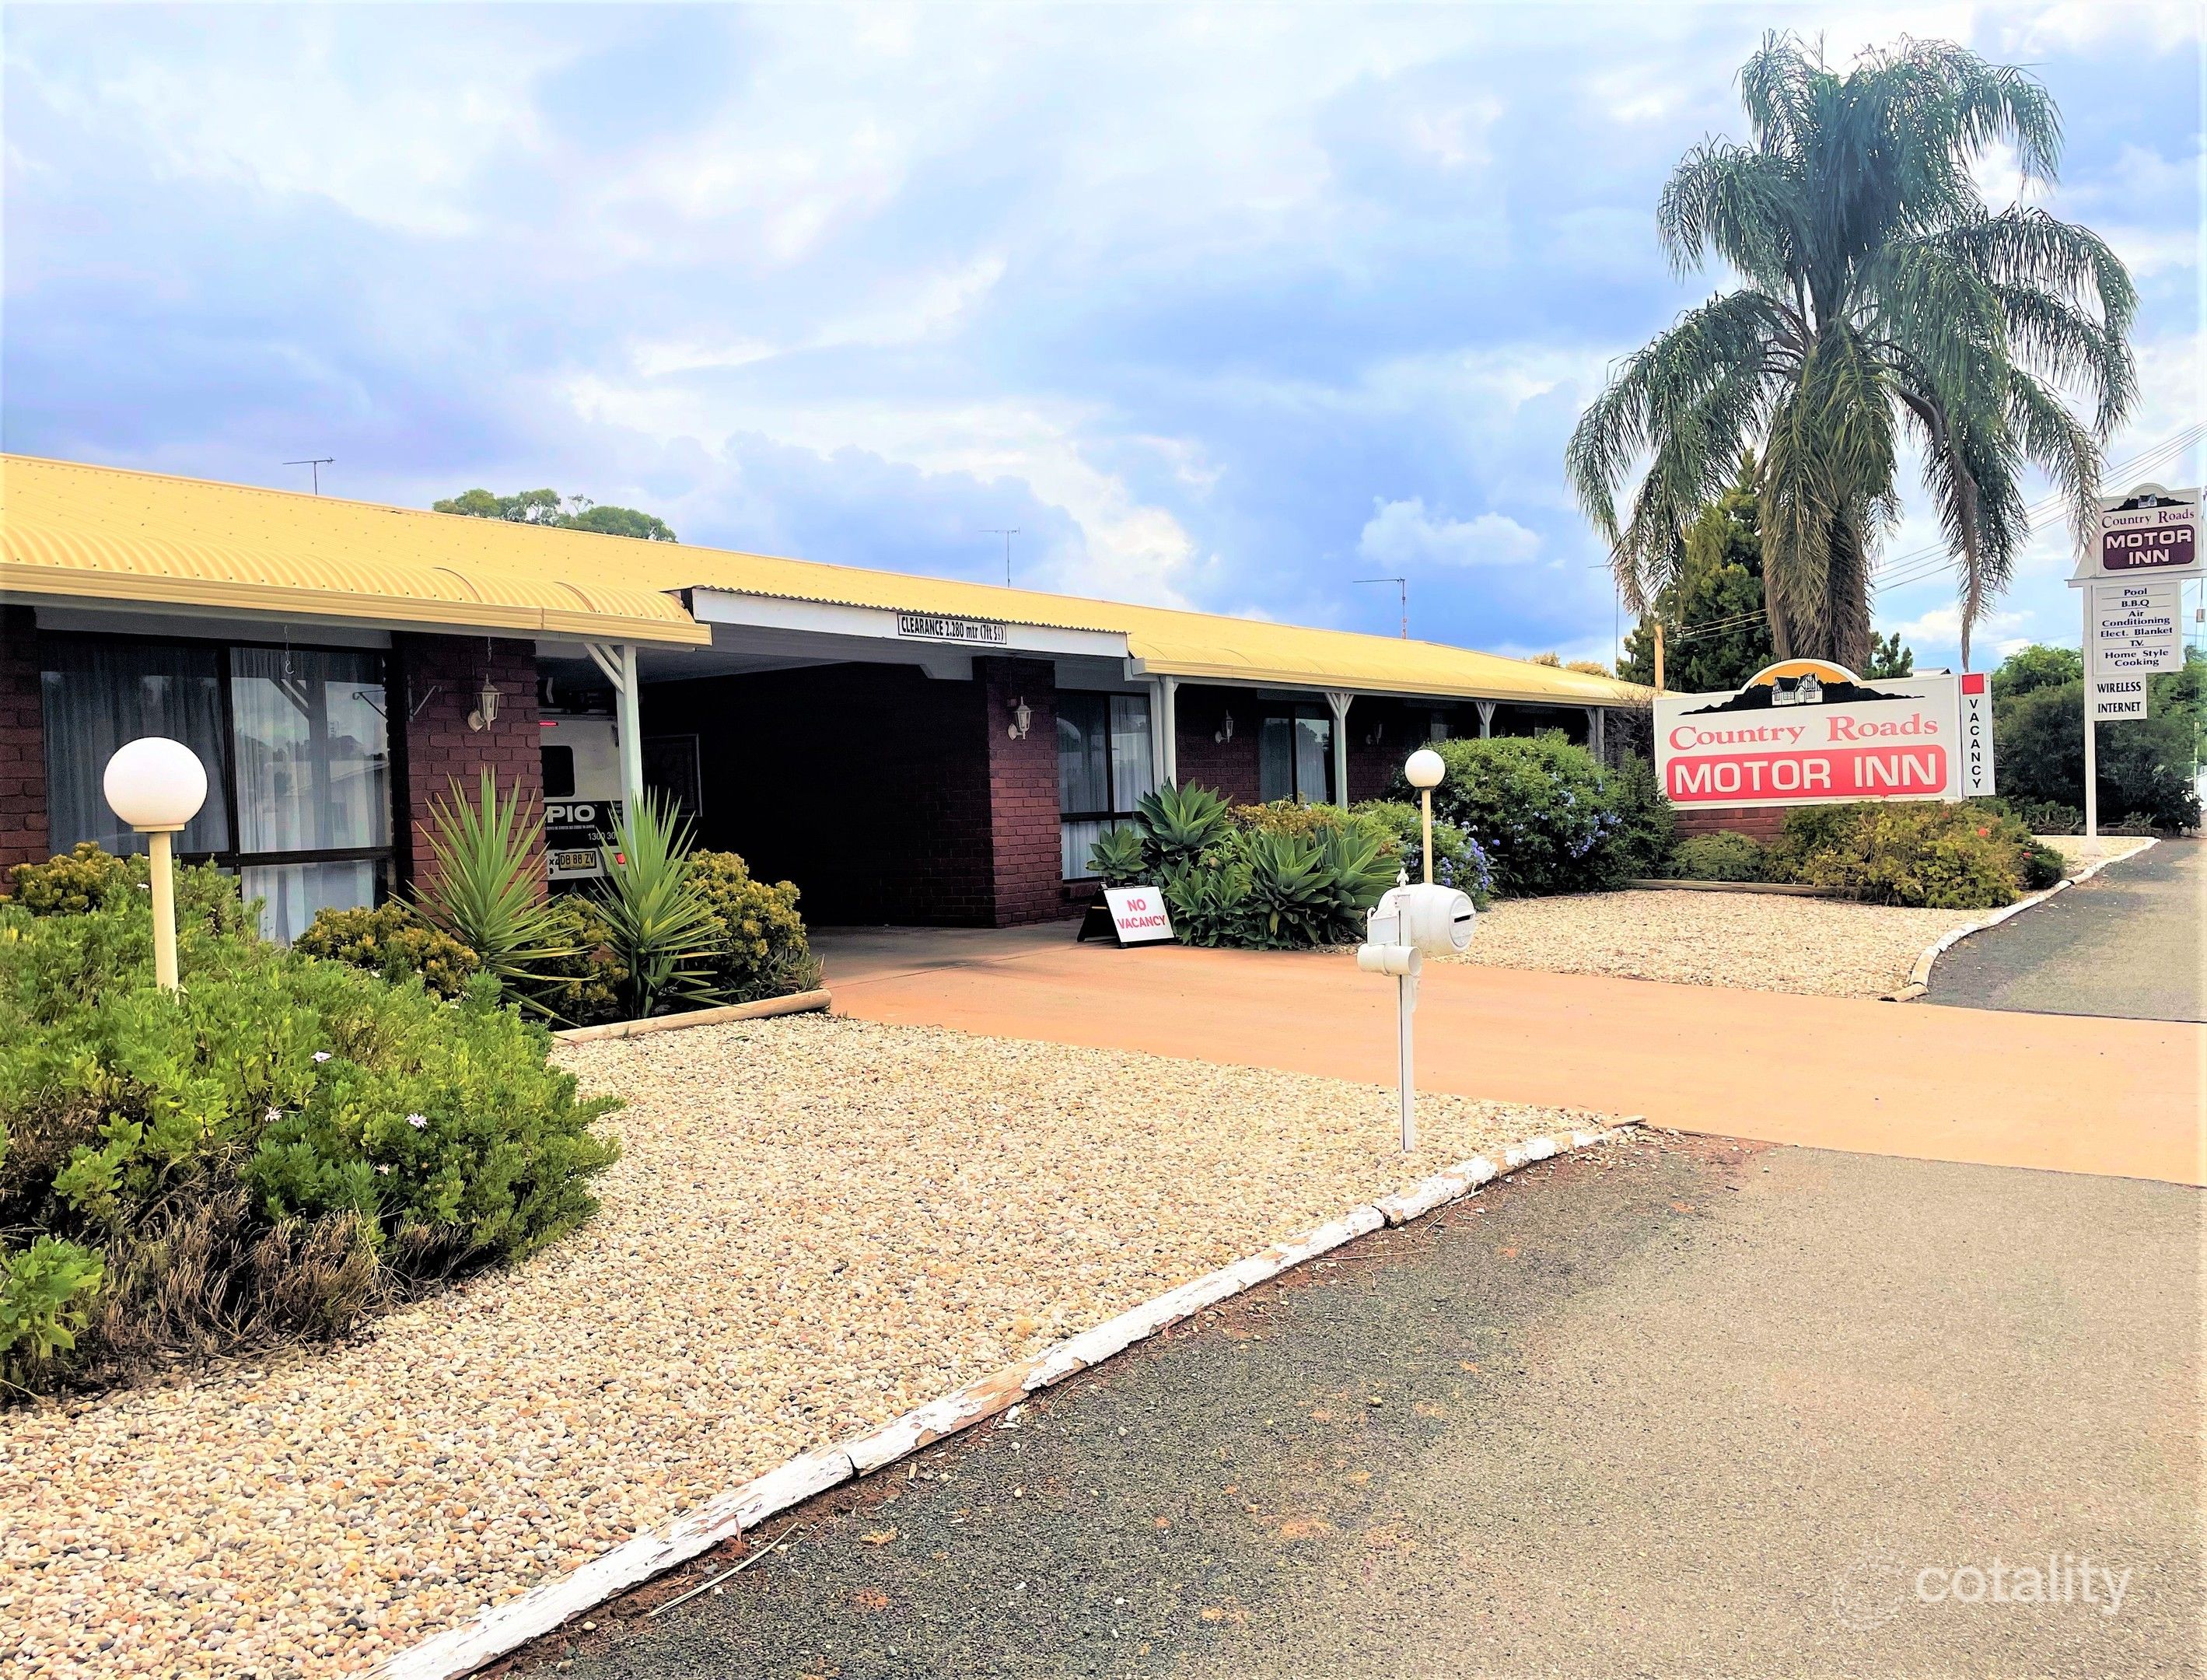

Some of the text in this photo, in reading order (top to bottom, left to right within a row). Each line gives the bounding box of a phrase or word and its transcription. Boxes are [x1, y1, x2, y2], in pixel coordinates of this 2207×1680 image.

[2101, 508, 2195, 529] Country Roads
[2106, 529, 2192, 549] MOTOR
[2128, 549, 2170, 565] INN
[2124, 587, 2147, 597] Pool
[2121, 599, 2149, 608] B.B.Q
[901, 616, 943, 636] CLEARANCE
[966, 625, 978, 639] mtr
[2101, 616, 2170, 628] Conditioning
[2100, 626, 2173, 638] Elect. Blanket
[2142, 649, 2169, 660] Style
[2114, 659, 2160, 669] Cooking
[2097, 681, 2141, 694] WIRELESS
[2097, 702, 2141, 714] INTERNET
[1669, 713, 1938, 751] Country Roads
[1970, 699, 1981, 789] VACANCY
[1675, 753, 1937, 795] MOTOR INN
[1127, 898, 1146, 912] NO
[1117, 915, 1166, 929] VACANCY
